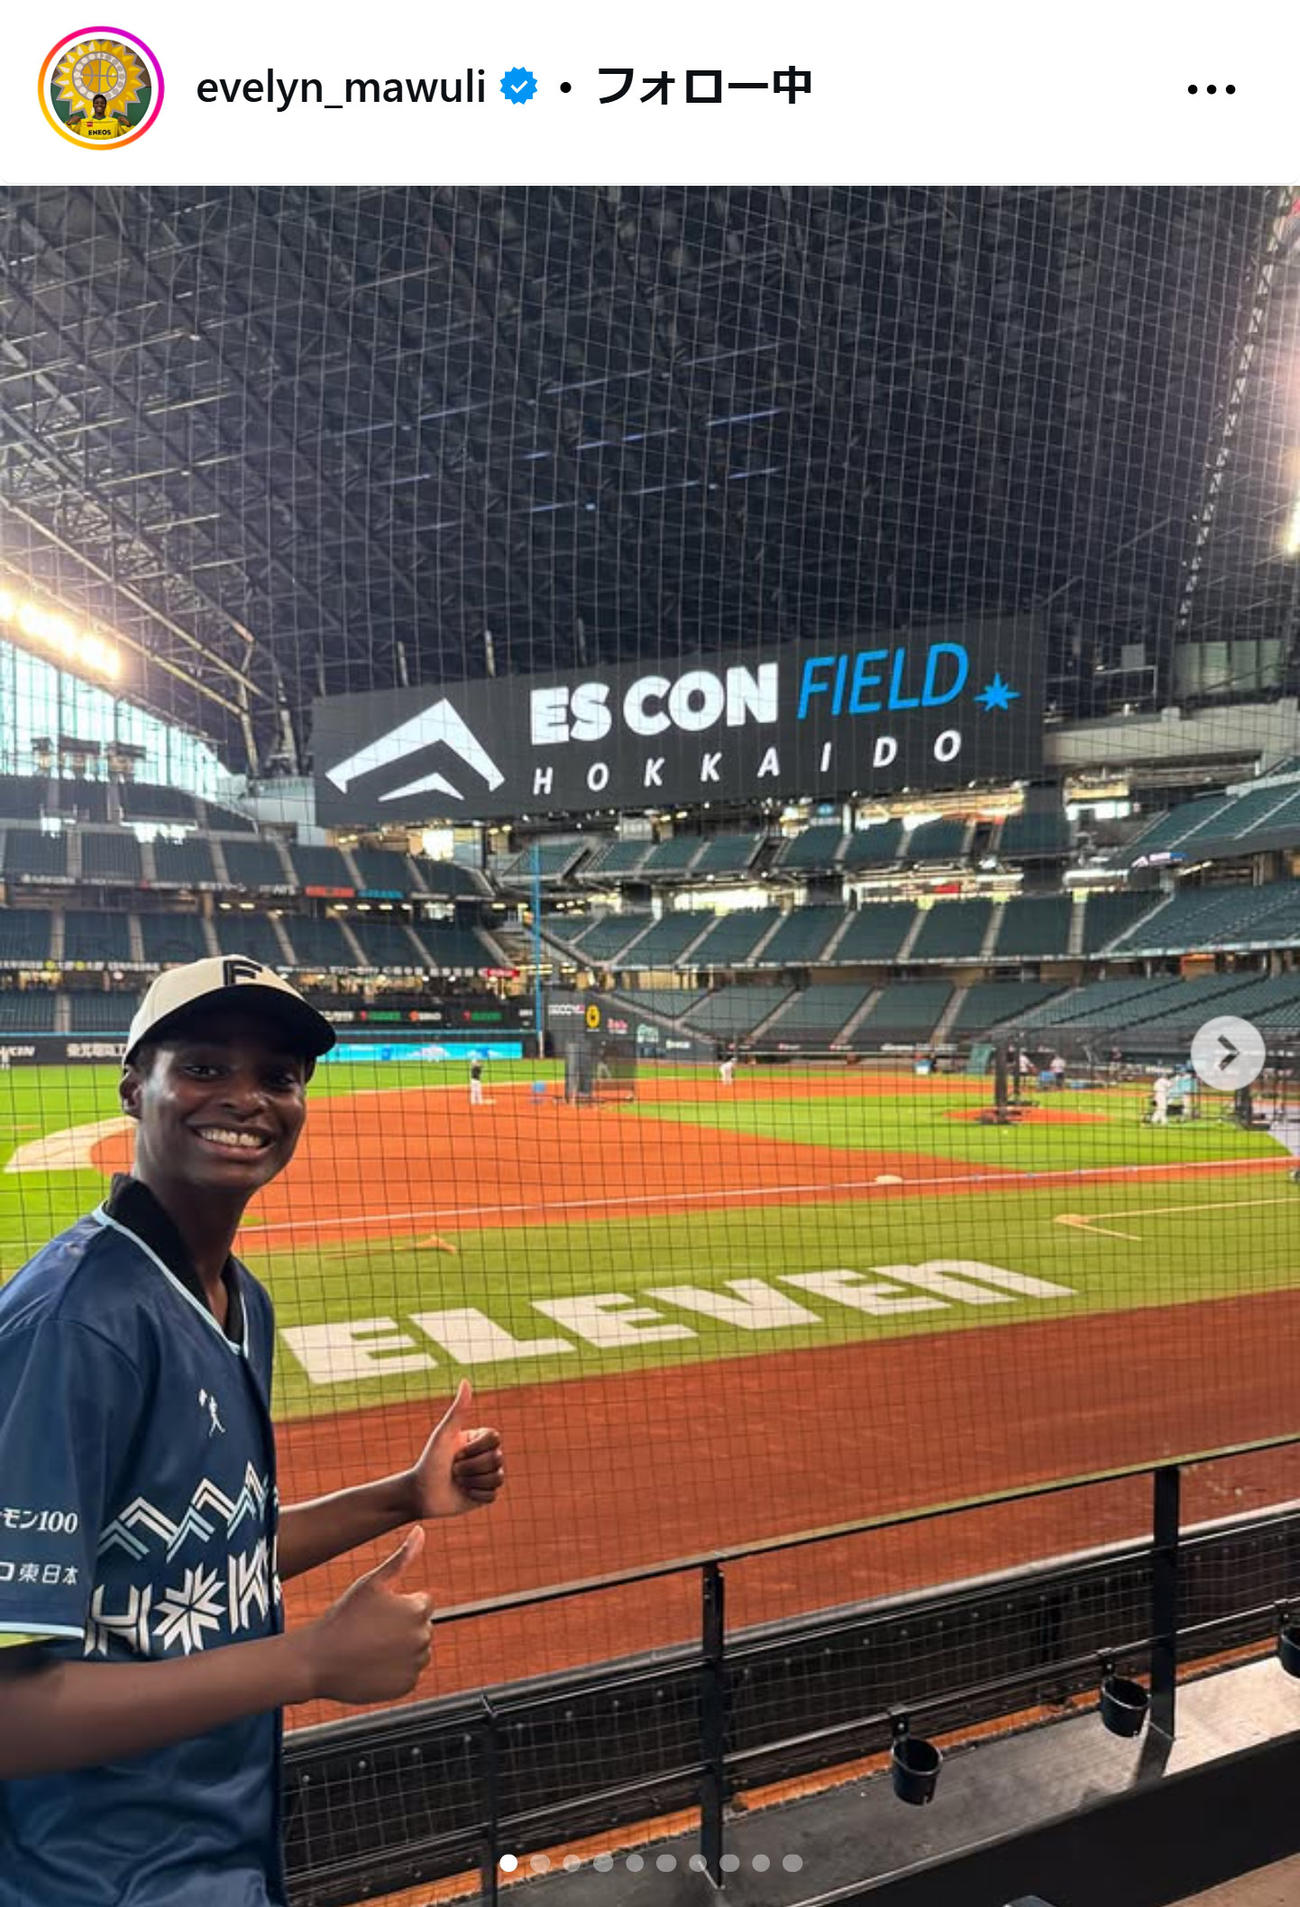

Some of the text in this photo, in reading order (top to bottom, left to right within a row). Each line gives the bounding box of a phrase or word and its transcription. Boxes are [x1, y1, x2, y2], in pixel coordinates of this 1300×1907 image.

[530, 641, 971, 746] ES CON FIELD
[532, 729, 964, 796] HOKKAIDO
[0, 1507, 79, 1534] モン100
